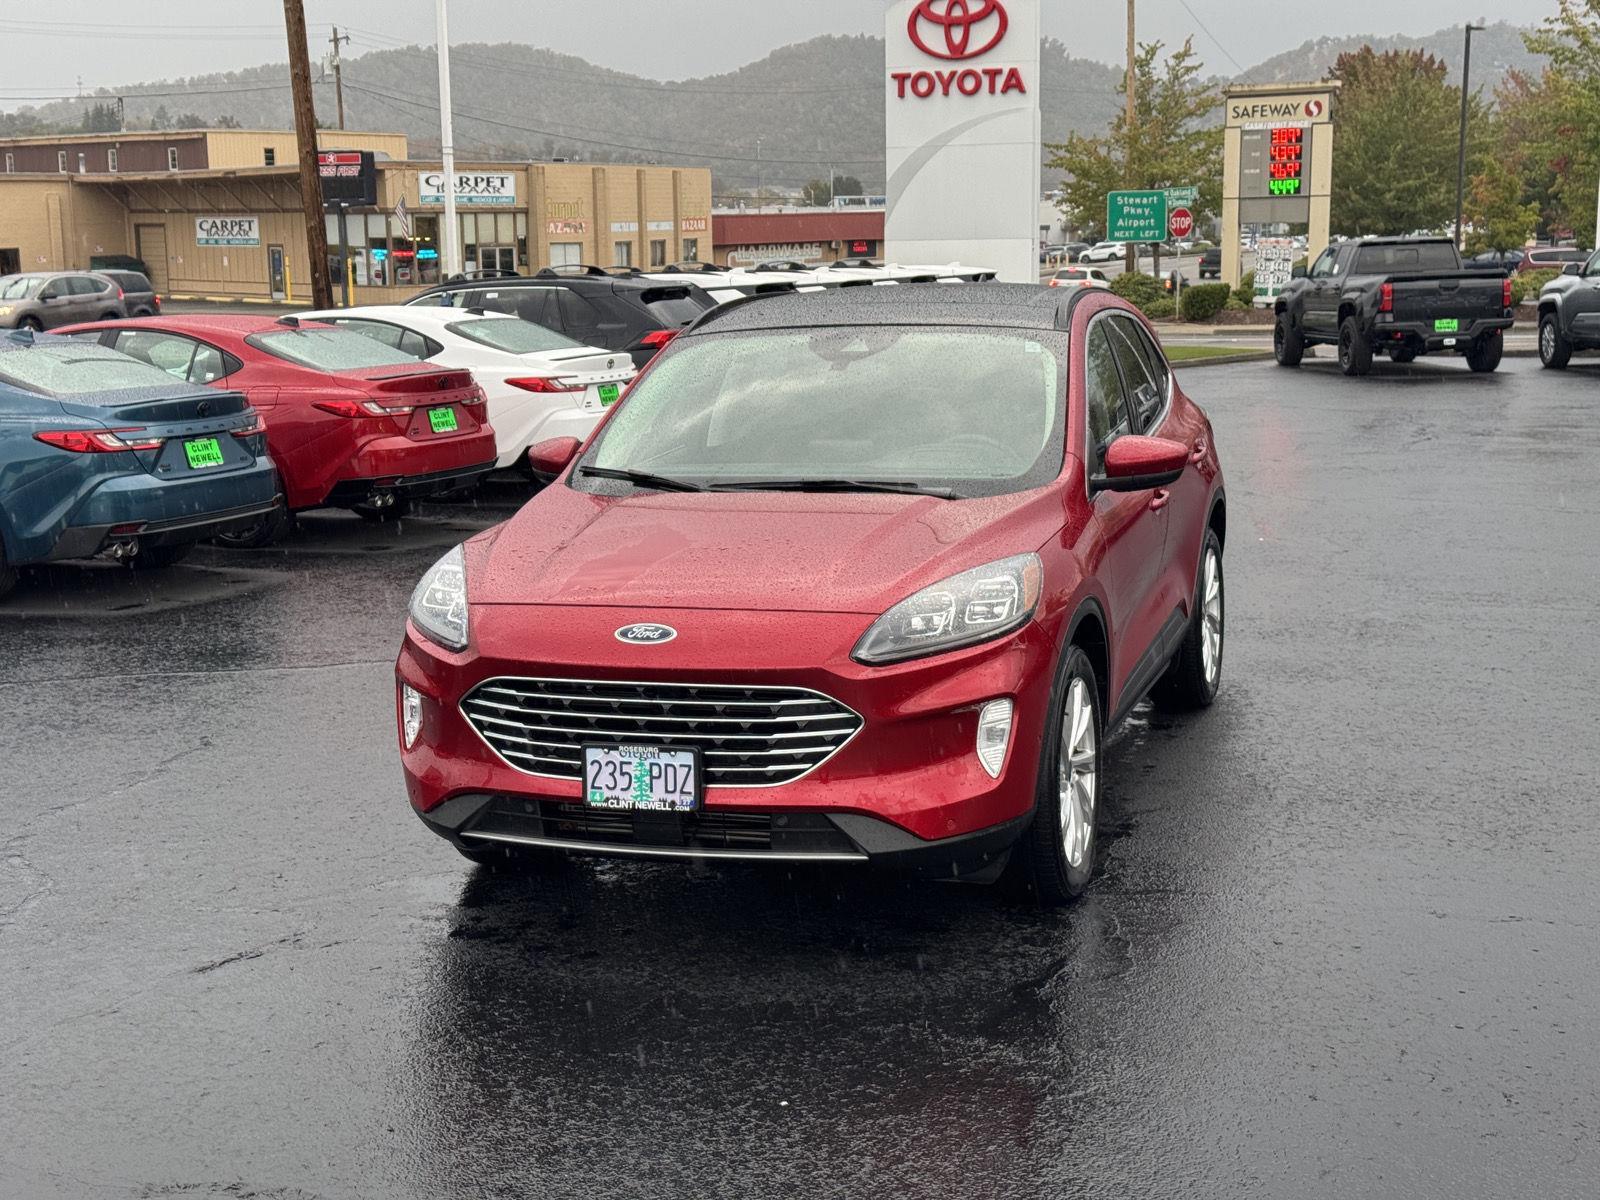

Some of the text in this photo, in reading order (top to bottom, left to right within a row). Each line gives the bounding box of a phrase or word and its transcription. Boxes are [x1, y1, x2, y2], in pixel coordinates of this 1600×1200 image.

[891, 68, 1026, 98] TOYOTA
[1232, 103, 1301, 119] SAFEWAY
[1117, 196, 1158, 205] Stewart
[199, 219, 254, 231] CARPET
[1117, 218, 1155, 228] Airport
[1171, 218, 1191, 230] STOP
[206, 229, 250, 237] BAZAAR
[737, 243, 821, 258] HARDWARE
[433, 420, 456, 428] NEWELL
[191, 442, 213, 452] CLINT
[190, 452, 221, 463] NEWELL
[627, 626, 662, 639] Ford
[618, 745, 660, 753] ROSEBURG
[590, 760, 692, 795] 235 PDZ
[608, 799, 634, 809] CLINT
[635, 801, 672, 811] NEWELL
